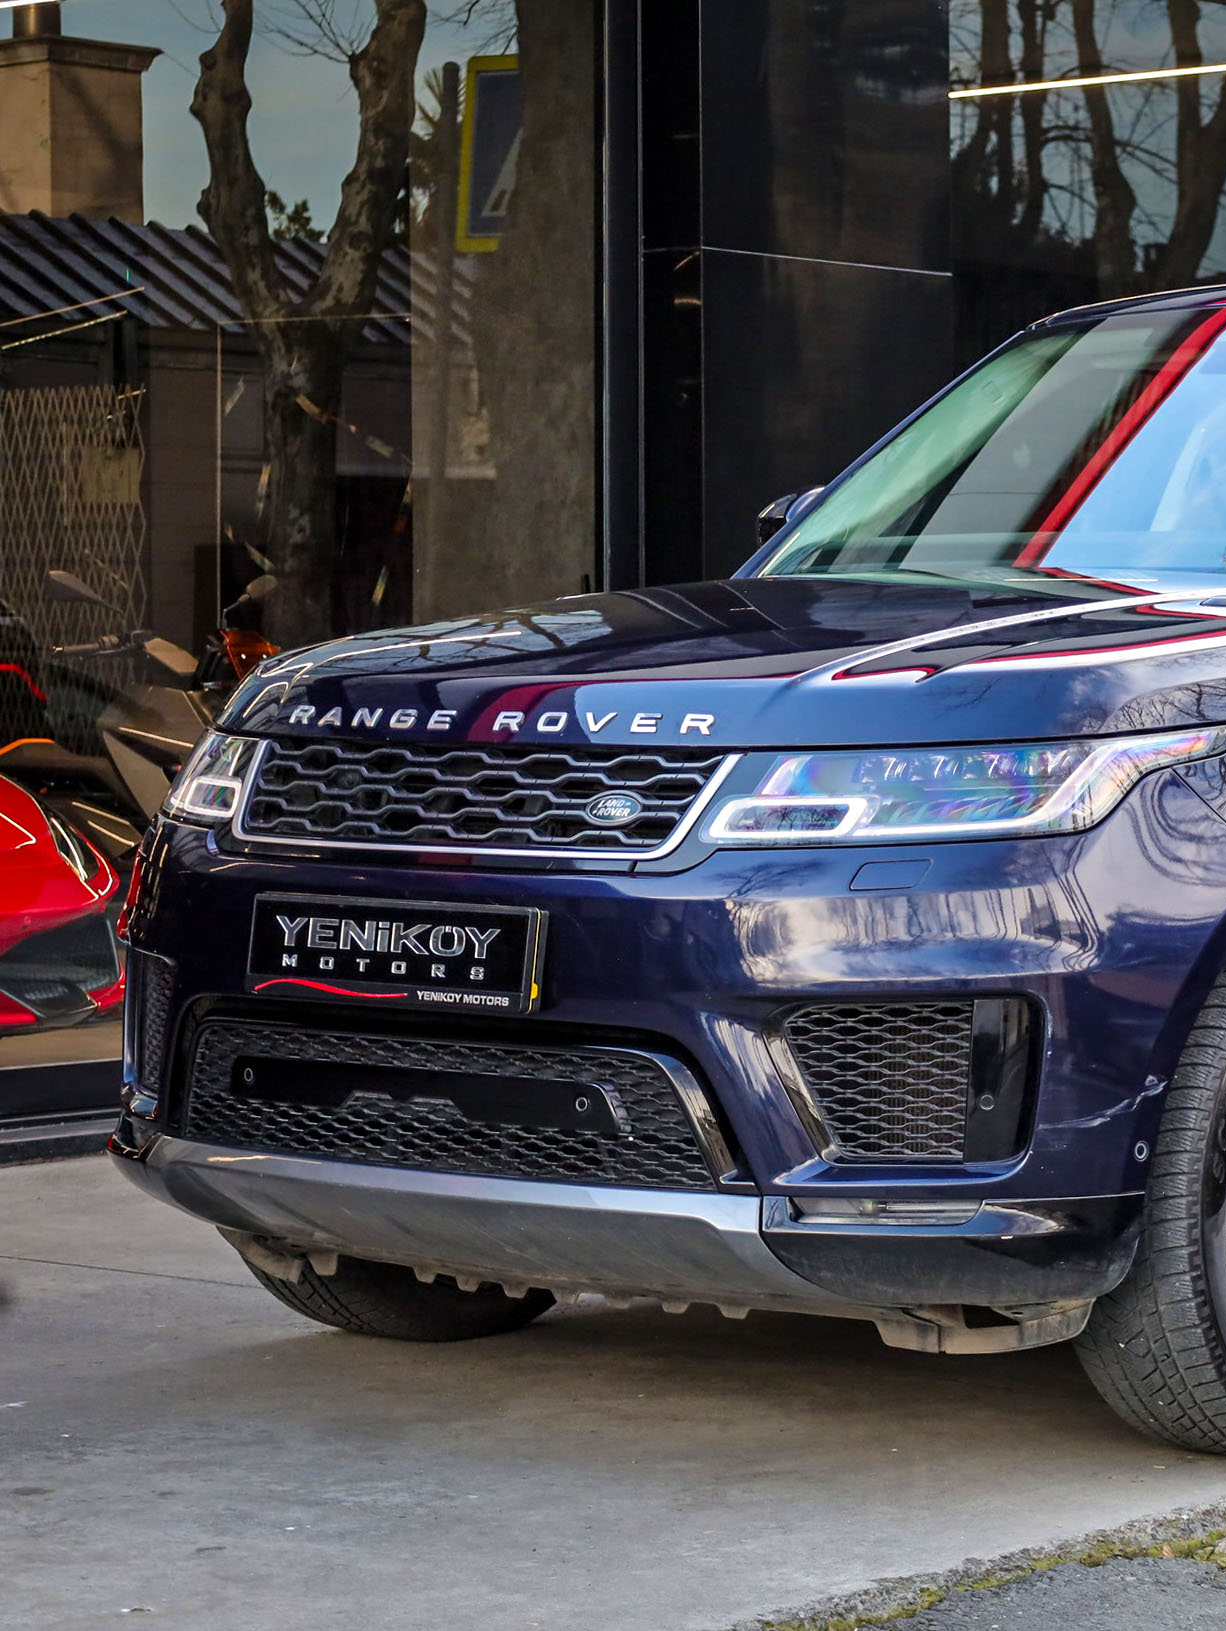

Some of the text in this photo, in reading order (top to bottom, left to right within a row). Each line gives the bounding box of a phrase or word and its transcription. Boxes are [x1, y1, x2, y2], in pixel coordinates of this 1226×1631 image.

[289, 704, 715, 736] RANGE ROVER
[282, 953, 484, 981] MOTORS
[463, 993, 510, 1007] MOTORS
